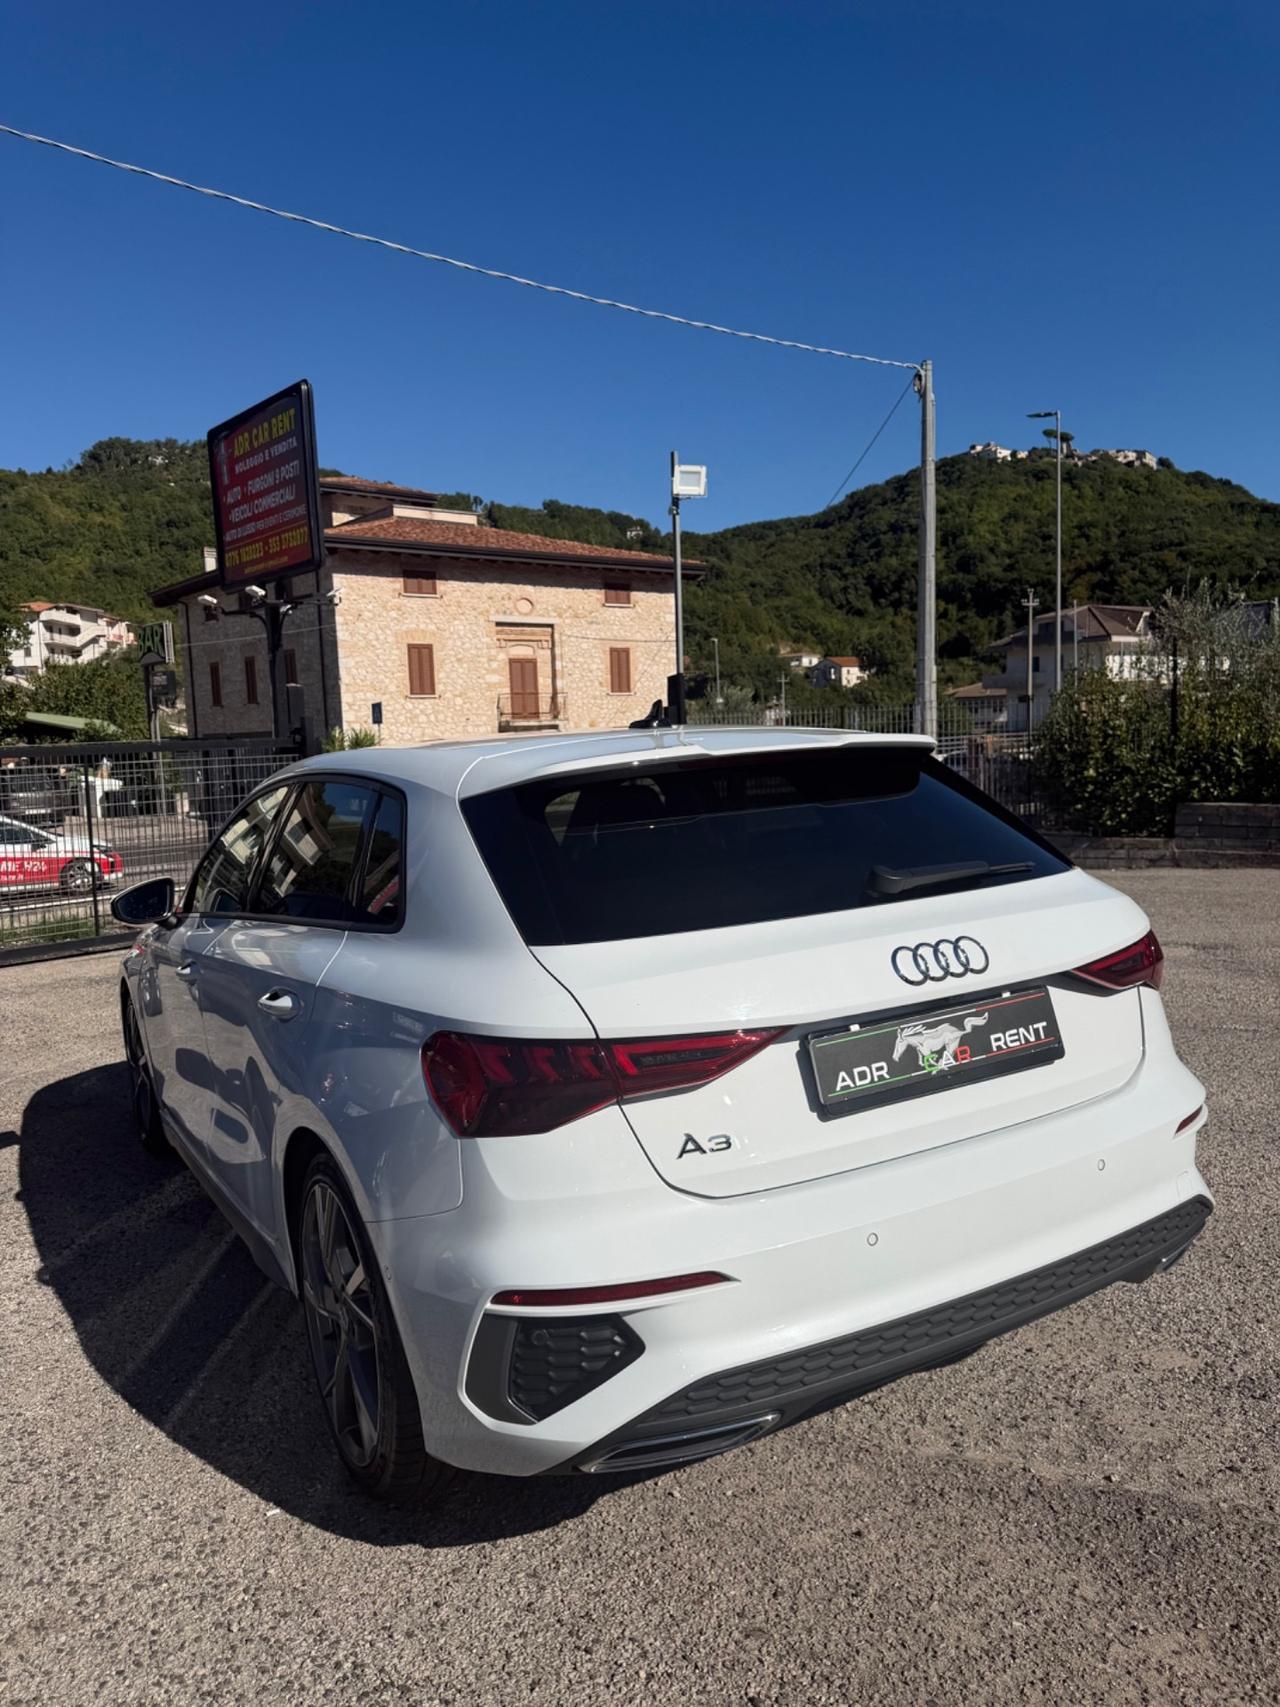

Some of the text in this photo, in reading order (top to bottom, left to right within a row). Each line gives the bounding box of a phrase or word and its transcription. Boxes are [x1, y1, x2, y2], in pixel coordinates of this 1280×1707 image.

[234, 408, 296, 458] ADR CAR RENT
[235, 436, 297, 474] NOLEGGIO E VENDITA
[247, 470, 275, 495] FURGONI
[280, 460, 300, 481] POSTI
[230, 483, 296, 523] VEICOLI COMMERCIALI
[138, 625, 165, 658] BAR
[836, 1021, 1048, 1091] ADR CAR RENT
[676, 1133, 732, 1160] A3
